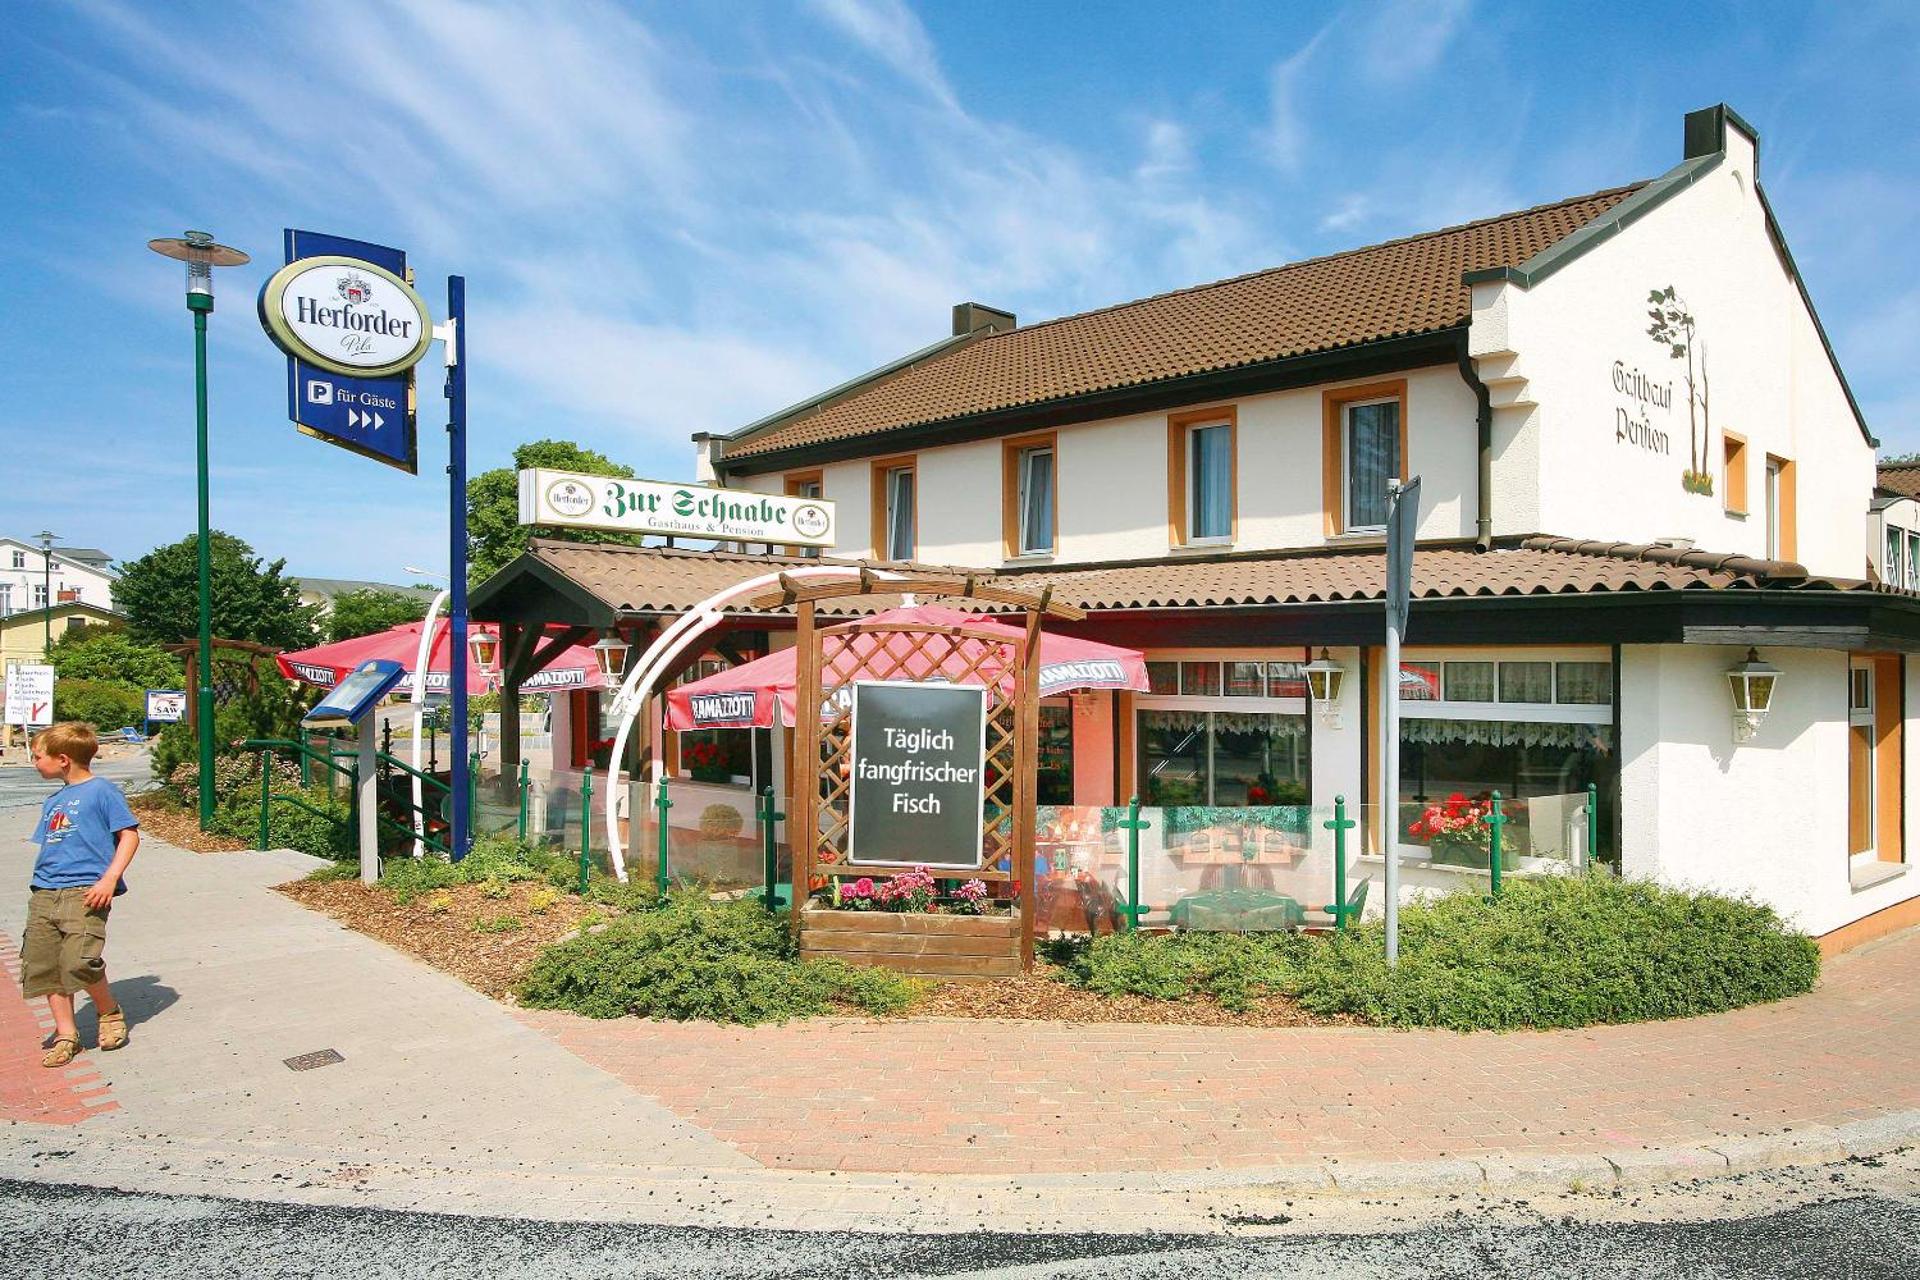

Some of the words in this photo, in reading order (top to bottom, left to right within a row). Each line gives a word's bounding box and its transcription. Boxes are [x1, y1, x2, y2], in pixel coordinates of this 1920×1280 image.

[297, 295, 412, 338] Herforder
[340, 333, 374, 353] Pils
[313, 384, 327, 400] P
[337, 388, 356, 402] für
[360, 392, 396, 409] Gäste
[603, 482, 662, 518] Zur
[672, 489, 787, 524] Schaabe
[648, 516, 701, 531] Gasthaus
[706, 523, 717, 533] &
[722, 524, 764, 536] Pension
[691, 695, 754, 719] RAMAZZOTTI
[884, 728, 954, 753] Täglich
[858, 758, 977, 785] fangfrischer
[892, 793, 941, 814] Fisch
